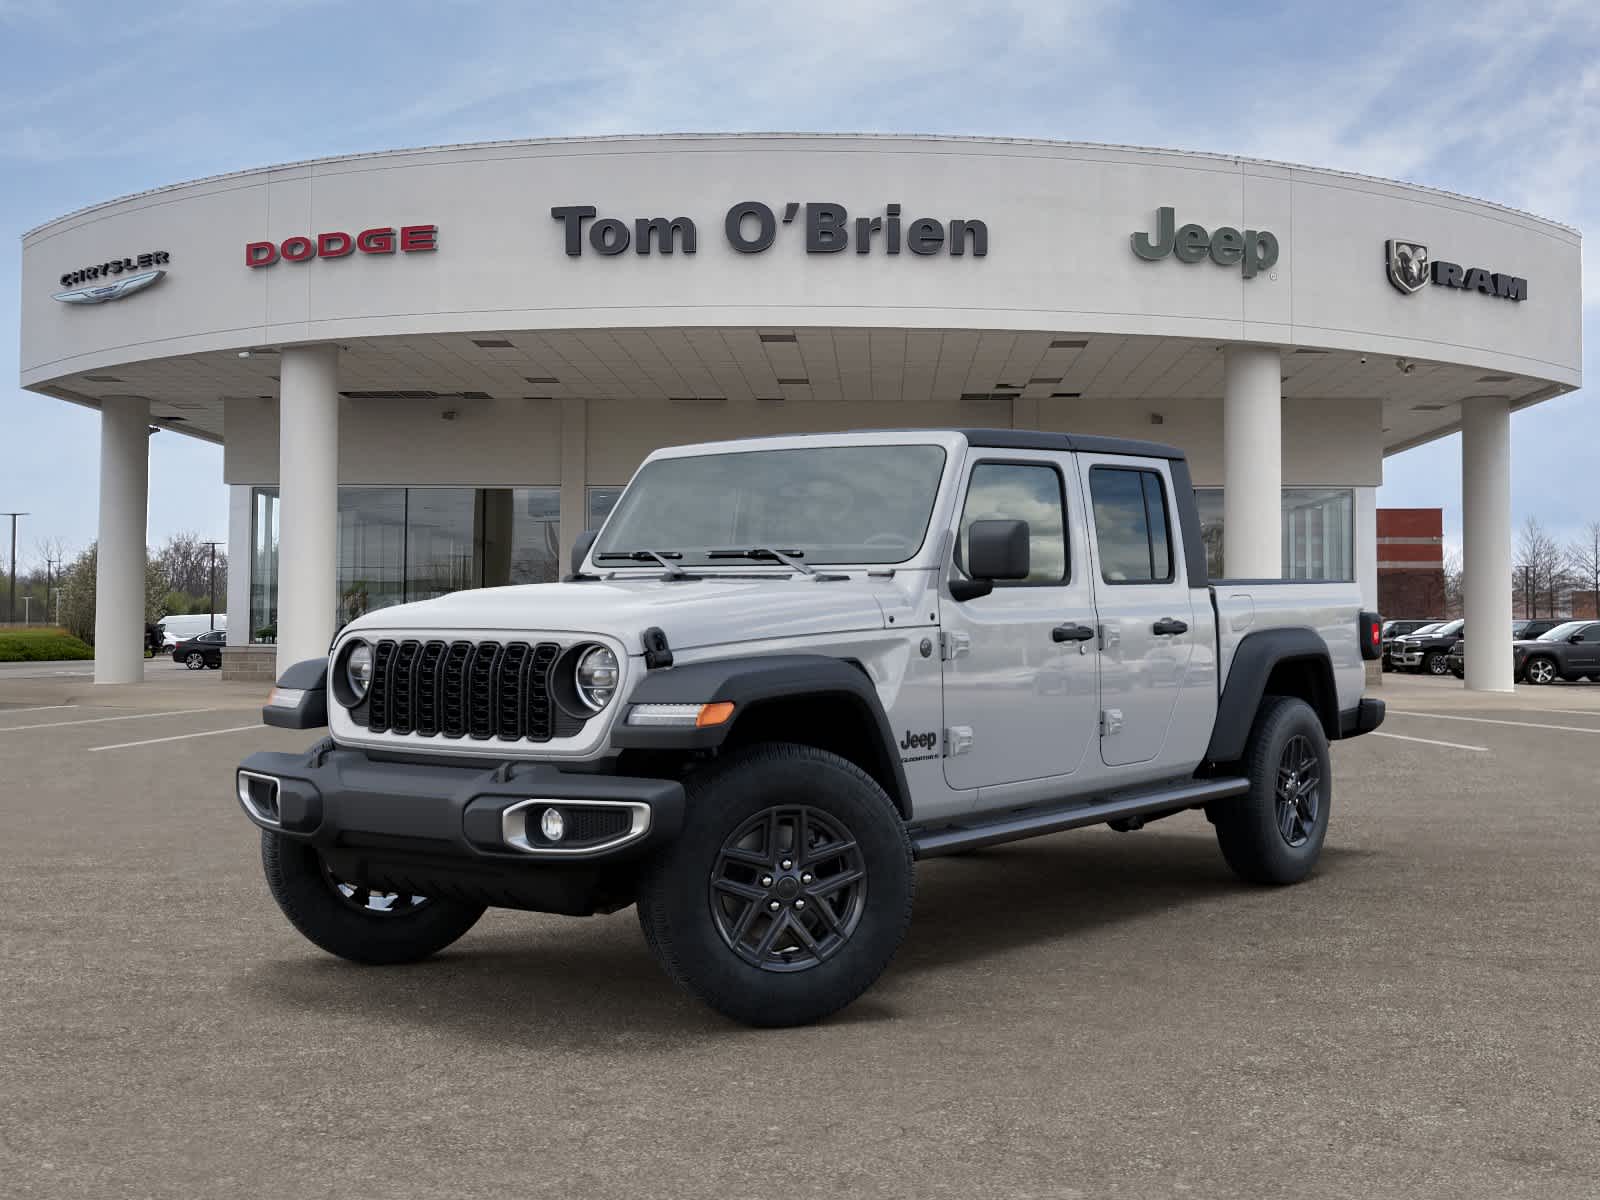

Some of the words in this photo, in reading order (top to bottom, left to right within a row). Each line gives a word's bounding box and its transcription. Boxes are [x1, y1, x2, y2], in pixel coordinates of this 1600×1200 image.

[246, 224, 438, 268] DODGE
[551, 205, 697, 256] Tom
[725, 201, 988, 257] O'Brien
[1130, 206, 1279, 279] Jeep
[60, 250, 170, 287] CHRYSLER
[1431, 260, 1528, 301] RAM
[900, 730, 937, 750] Jeep
